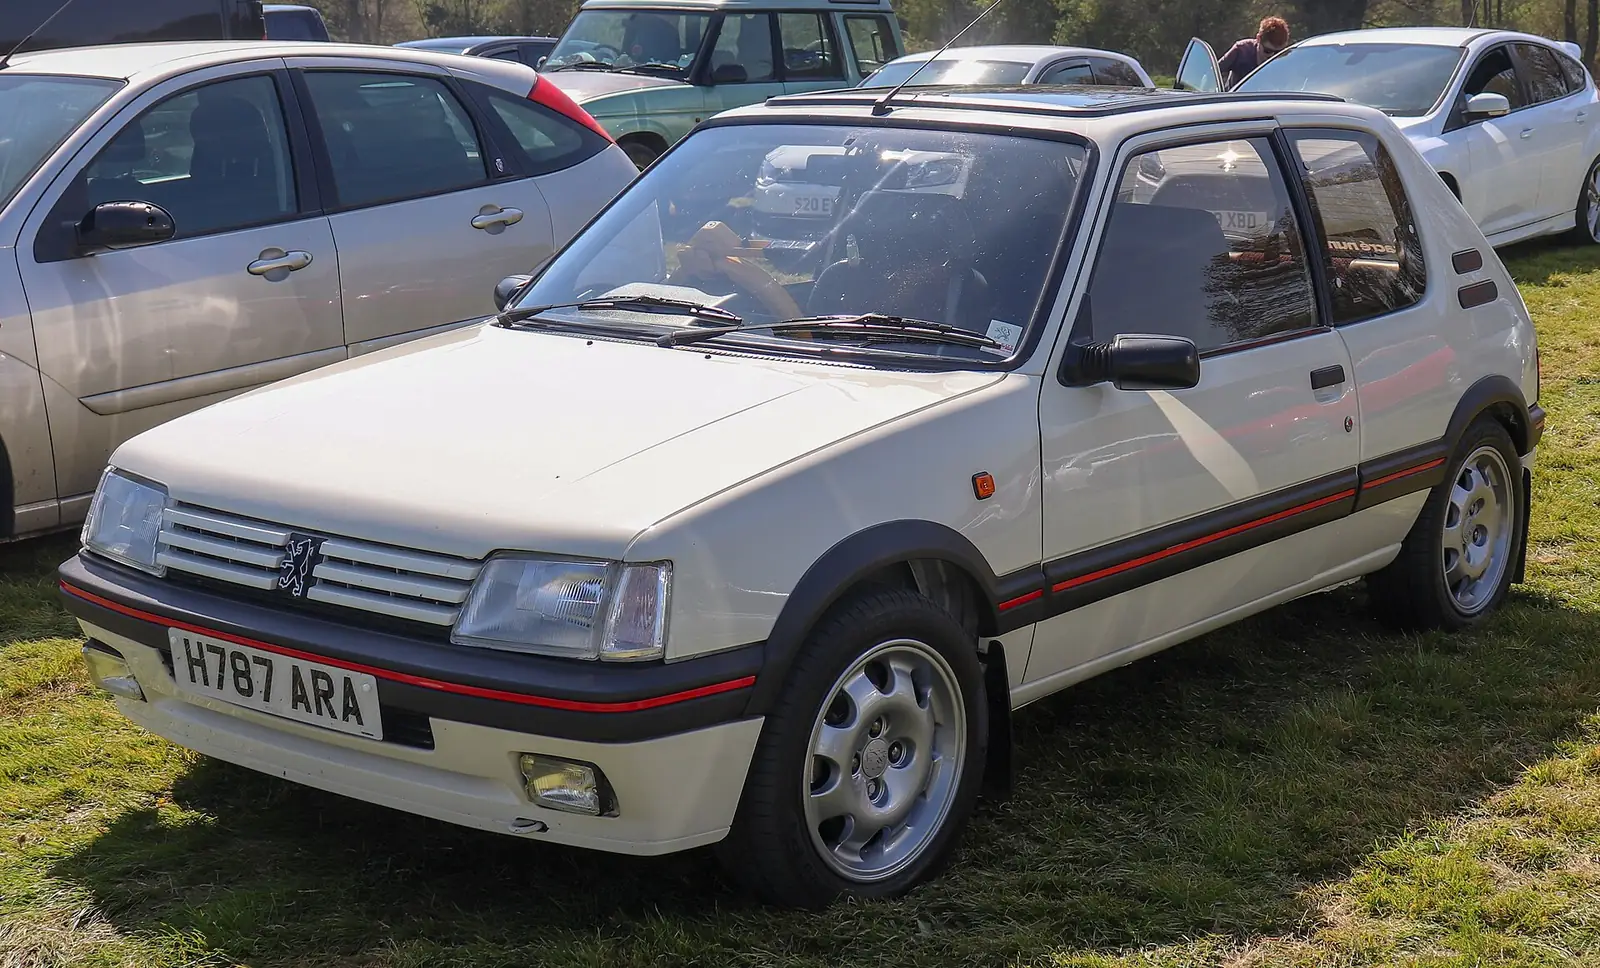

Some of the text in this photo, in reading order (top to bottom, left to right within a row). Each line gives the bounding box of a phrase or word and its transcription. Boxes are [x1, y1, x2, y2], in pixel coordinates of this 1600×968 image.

[794, 197, 819, 212] S20
[183, 637, 365, 727] H787 ARA
